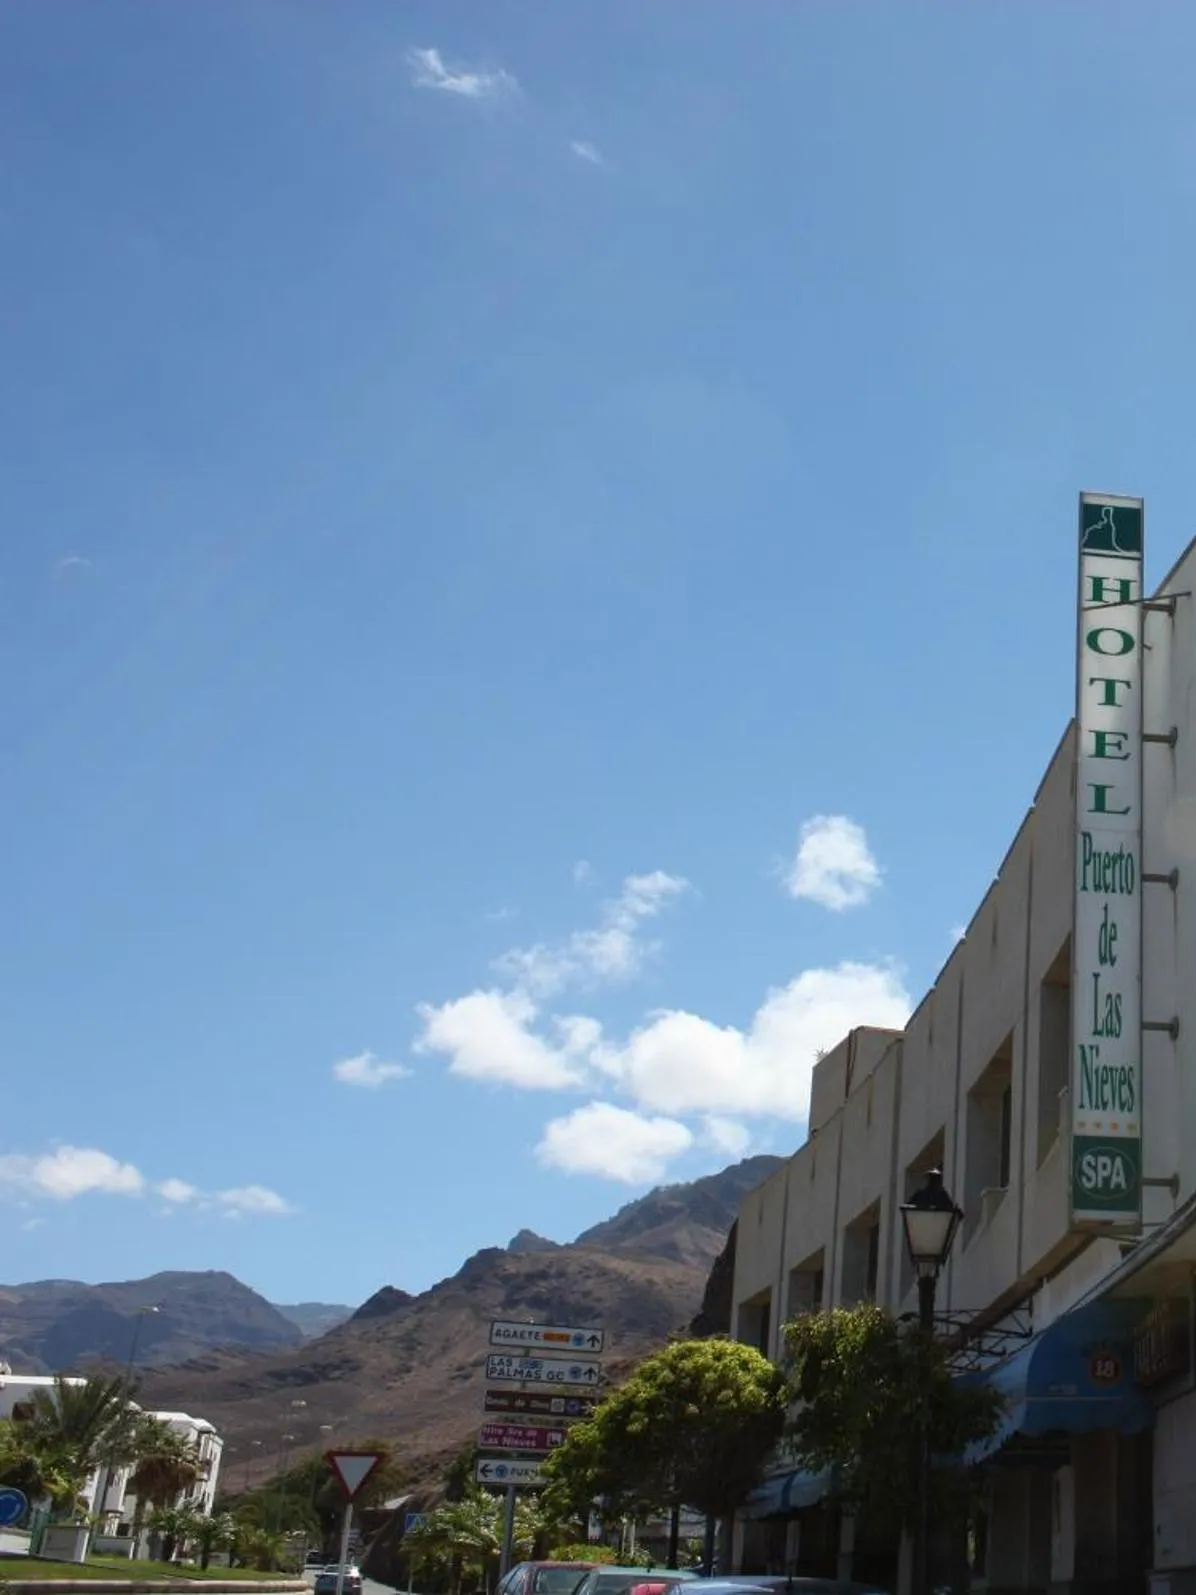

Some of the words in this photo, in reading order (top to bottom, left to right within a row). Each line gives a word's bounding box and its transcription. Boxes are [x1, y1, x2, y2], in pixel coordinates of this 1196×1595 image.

[1085, 575, 1136, 815] HOTEL
[1080, 831, 1135, 895] Puerto
[1098, 904, 1118, 967] de
[1092, 973, 1122, 1038] Las
[1078, 1044, 1135, 1113] Nieves
[1080, 1154, 1127, 1191] SPA
[490, 1356, 513, 1367] LAS
[494, 1329, 540, 1341] AGAETE
[488, 1366, 543, 1380] PALMAS
